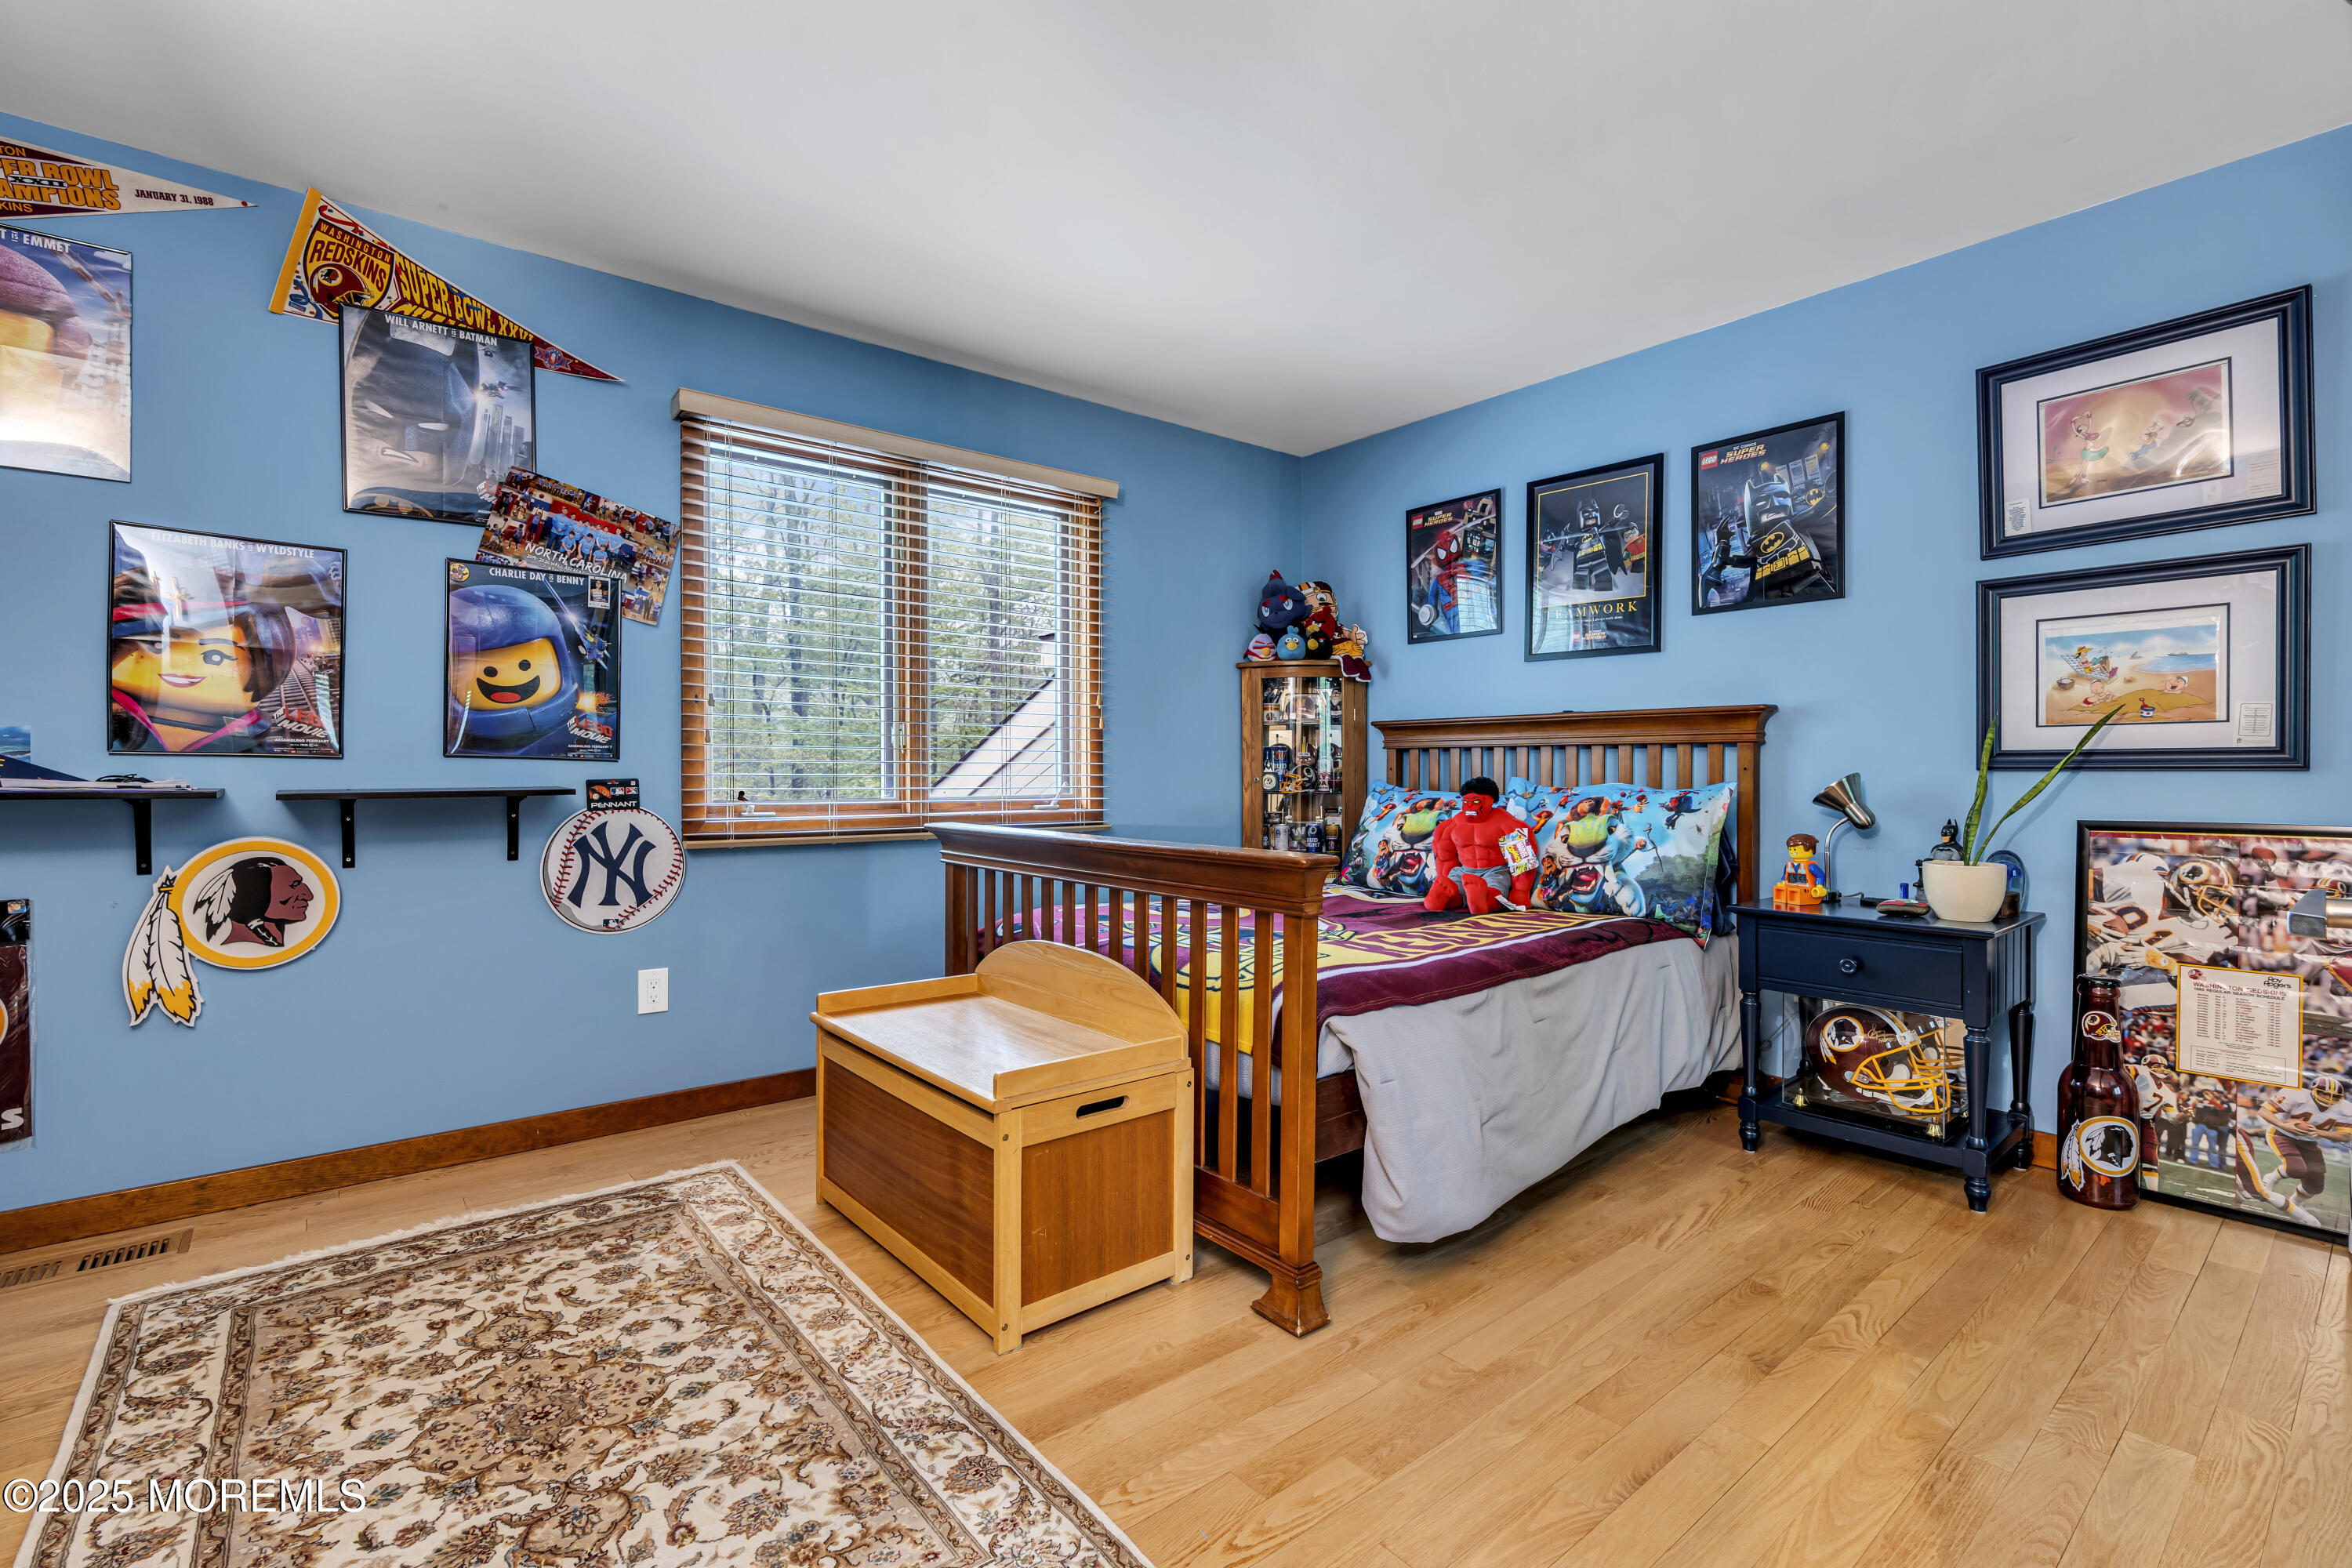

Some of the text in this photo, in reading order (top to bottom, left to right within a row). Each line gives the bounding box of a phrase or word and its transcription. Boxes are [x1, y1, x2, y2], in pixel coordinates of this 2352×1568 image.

[135, 189, 177, 201] JANUARY
[193, 195, 214, 206] 1988
[23, 233, 71, 253] EMMET
[321, 223, 391, 263] WASHINGTON
[309, 240, 387, 292] REDSKINS
[395, 252, 452, 318] SUPER
[453, 294, 495, 334] BOWL
[384, 314, 408, 328] WILL
[412, 320, 448, 336] ARNETT
[459, 331, 498, 346] BATMAN
[1702, 455, 1716, 465] LEGO
[1720, 449, 1766, 465] HEROES
[1726, 444, 1765, 458] SUPER
[1424, 517, 1453, 527] HEROES
[1428, 512, 1453, 521] SUPER
[151, 532, 207, 546] ELIZABETH
[210, 538, 245, 550] BANKS
[256, 543, 314, 558] WYLDSTYLE
[524, 540, 628, 584] NORTH CAROLINA
[489, 567, 527, 579] CHARLIE
[529, 572, 546, 581] DAY
[557, 575, 585, 586] BENNY
[274, 706, 322, 728] THE LEG
[567, 715, 613, 737] THE LEGO
[277, 719, 328, 738] MOVIE
[570, 728, 612, 743] MOVIE
[567, 820, 657, 909] NY
[2263, 980, 2292, 989] Rogers
